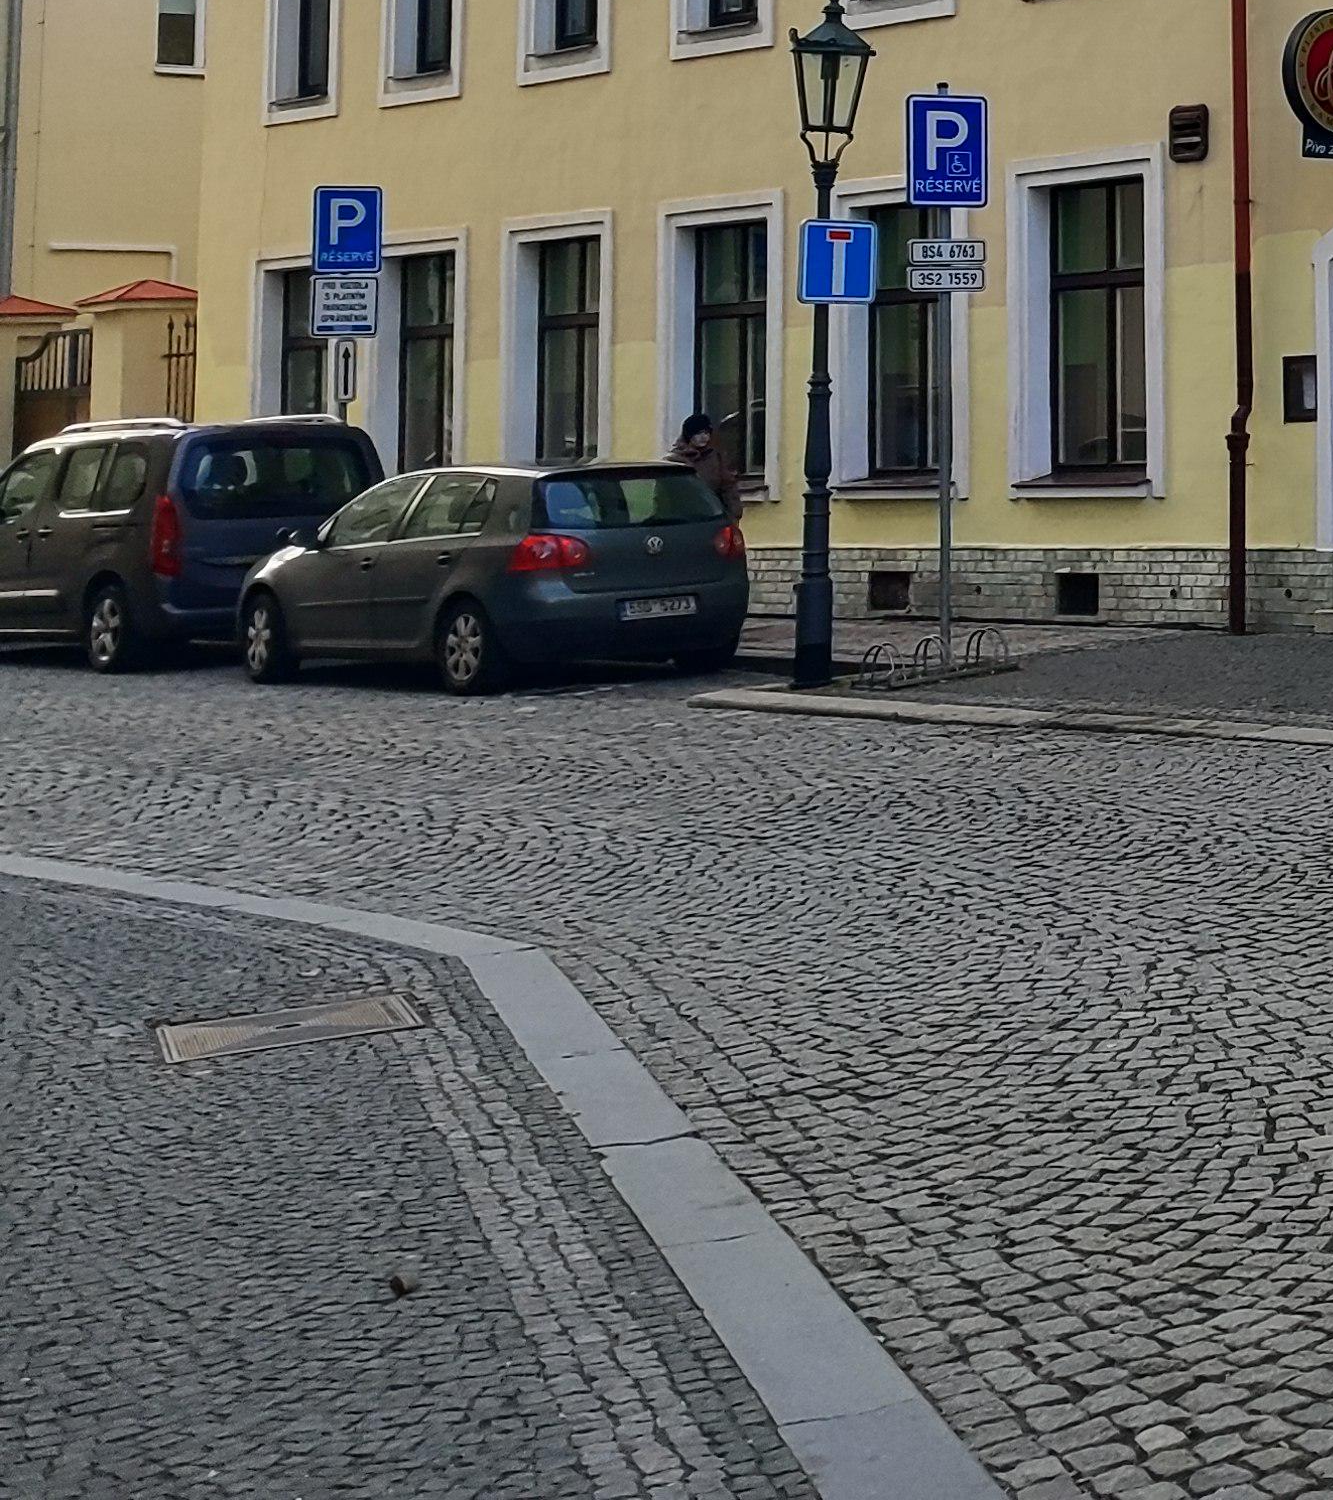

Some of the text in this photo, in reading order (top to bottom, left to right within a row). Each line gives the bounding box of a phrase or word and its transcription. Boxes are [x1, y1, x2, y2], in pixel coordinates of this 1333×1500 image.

[926, 110, 969, 171] P
[915, 176, 981, 193] RÉSERVÉ
[329, 198, 366, 245] P
[320, 250, 374, 262] RÉSERVÉ
[921, 244, 976, 259] 8S4 6763
[917, 272, 978, 286] 3S2 1559
